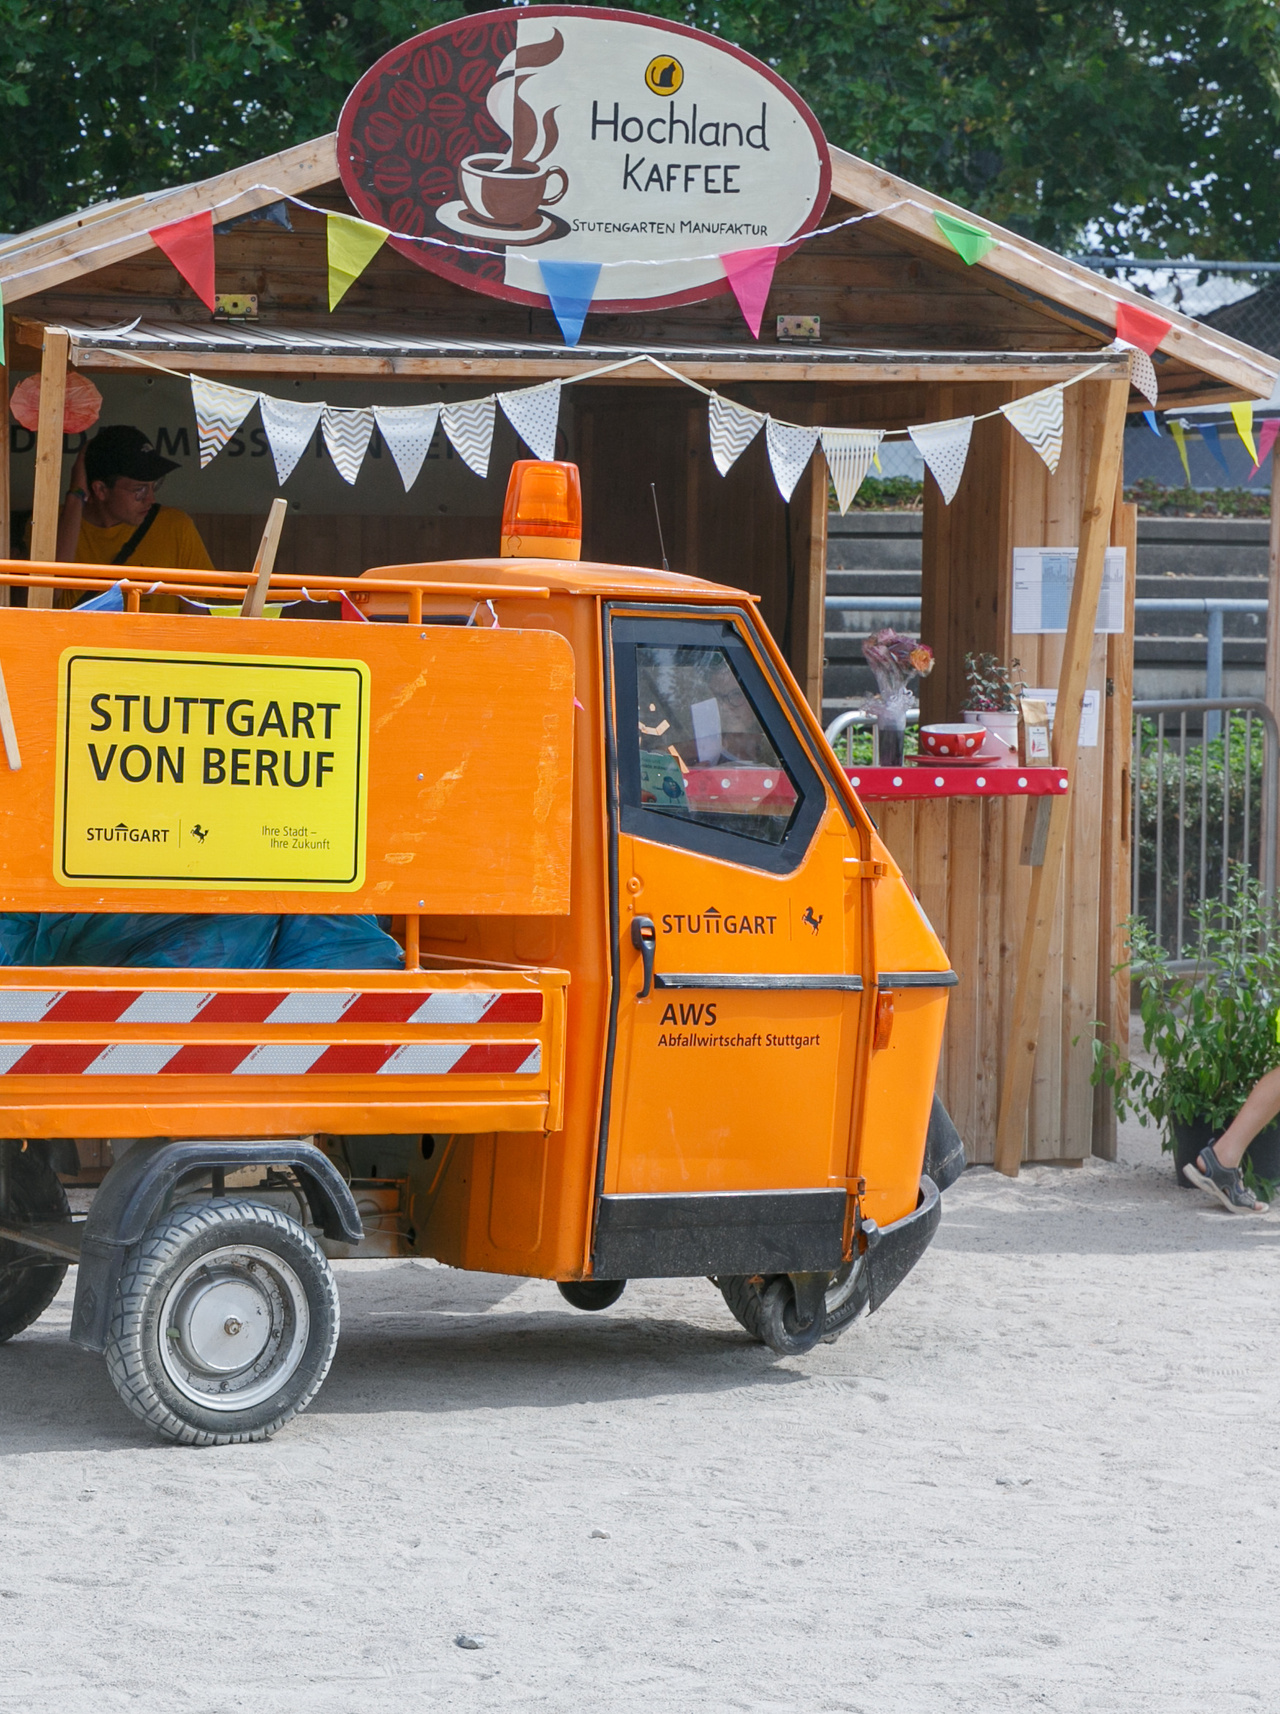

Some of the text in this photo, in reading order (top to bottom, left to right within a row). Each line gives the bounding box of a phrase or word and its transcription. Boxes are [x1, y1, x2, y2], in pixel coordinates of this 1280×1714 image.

[591, 100, 770, 152] Hochland
[622, 153, 741, 194] KAFFEE
[571, 217, 769, 237] STUTENGARTEN MANUFAKTUR
[90, 693, 341, 739] STUTTGART
[88, 743, 335, 788] VON BERUF
[86, 822, 170, 843] STUTTGART
[262, 825, 280, 837] Ihre
[283, 826, 308, 838] Stadt
[270, 838, 330, 850] Ihre Zukunft
[662, 906, 777, 935] STUTTGART
[660, 1003, 717, 1026] AWS
[658, 1033, 820, 1050] Abfallwirtschaft Stuttgart
